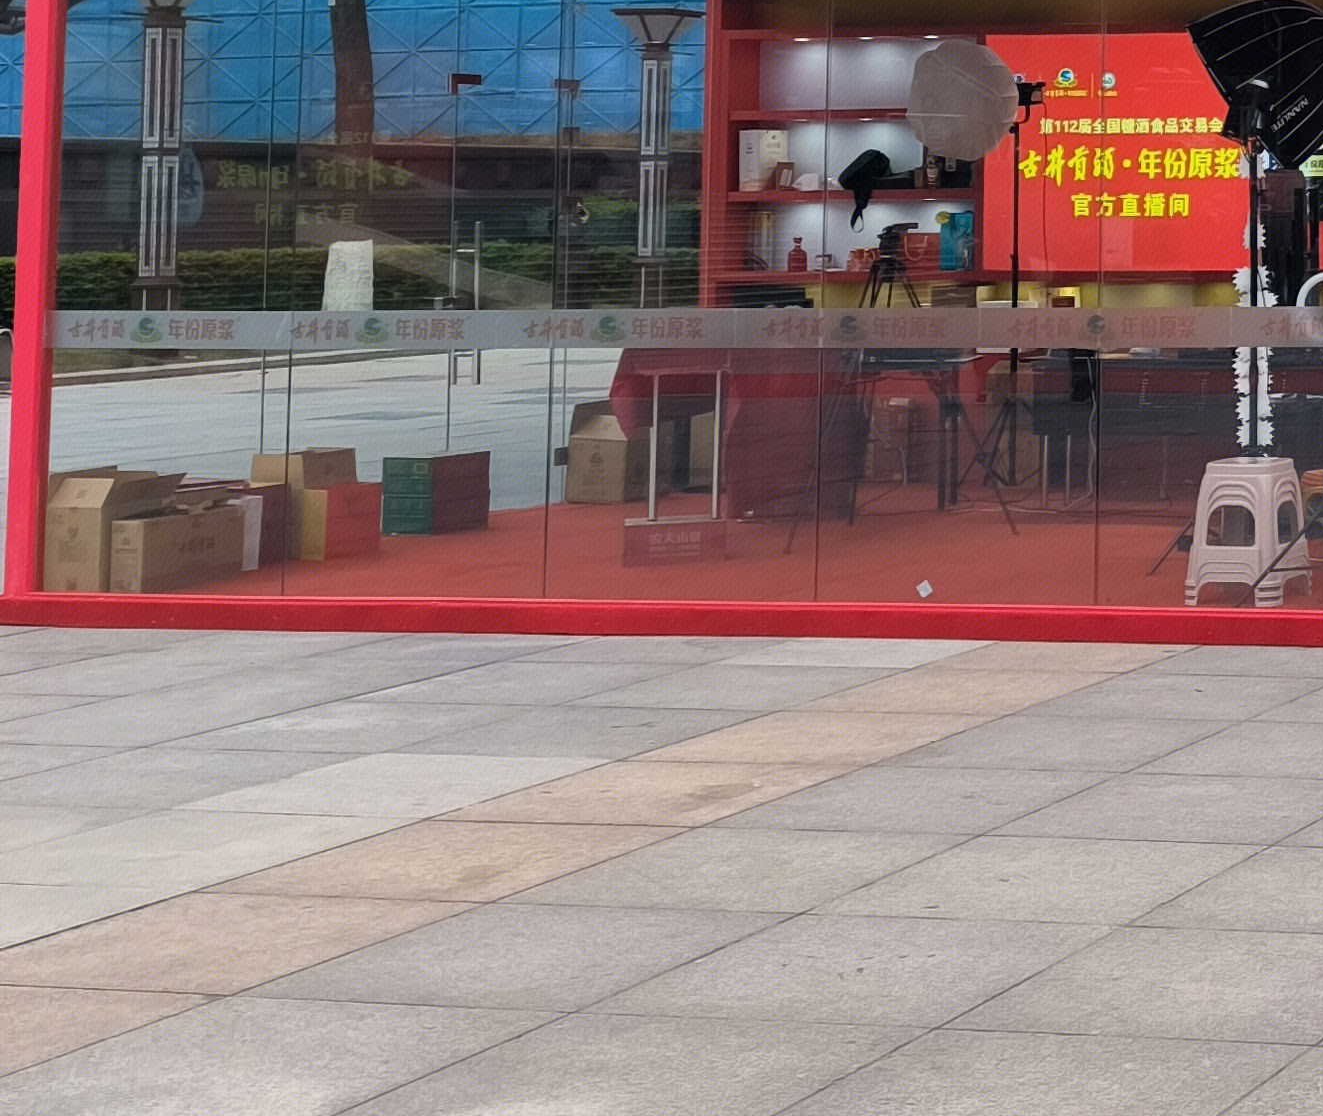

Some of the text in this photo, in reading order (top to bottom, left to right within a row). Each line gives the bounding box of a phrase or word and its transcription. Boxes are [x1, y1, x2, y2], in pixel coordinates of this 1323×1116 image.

[1071, 193, 1190, 218] 官方直播间
